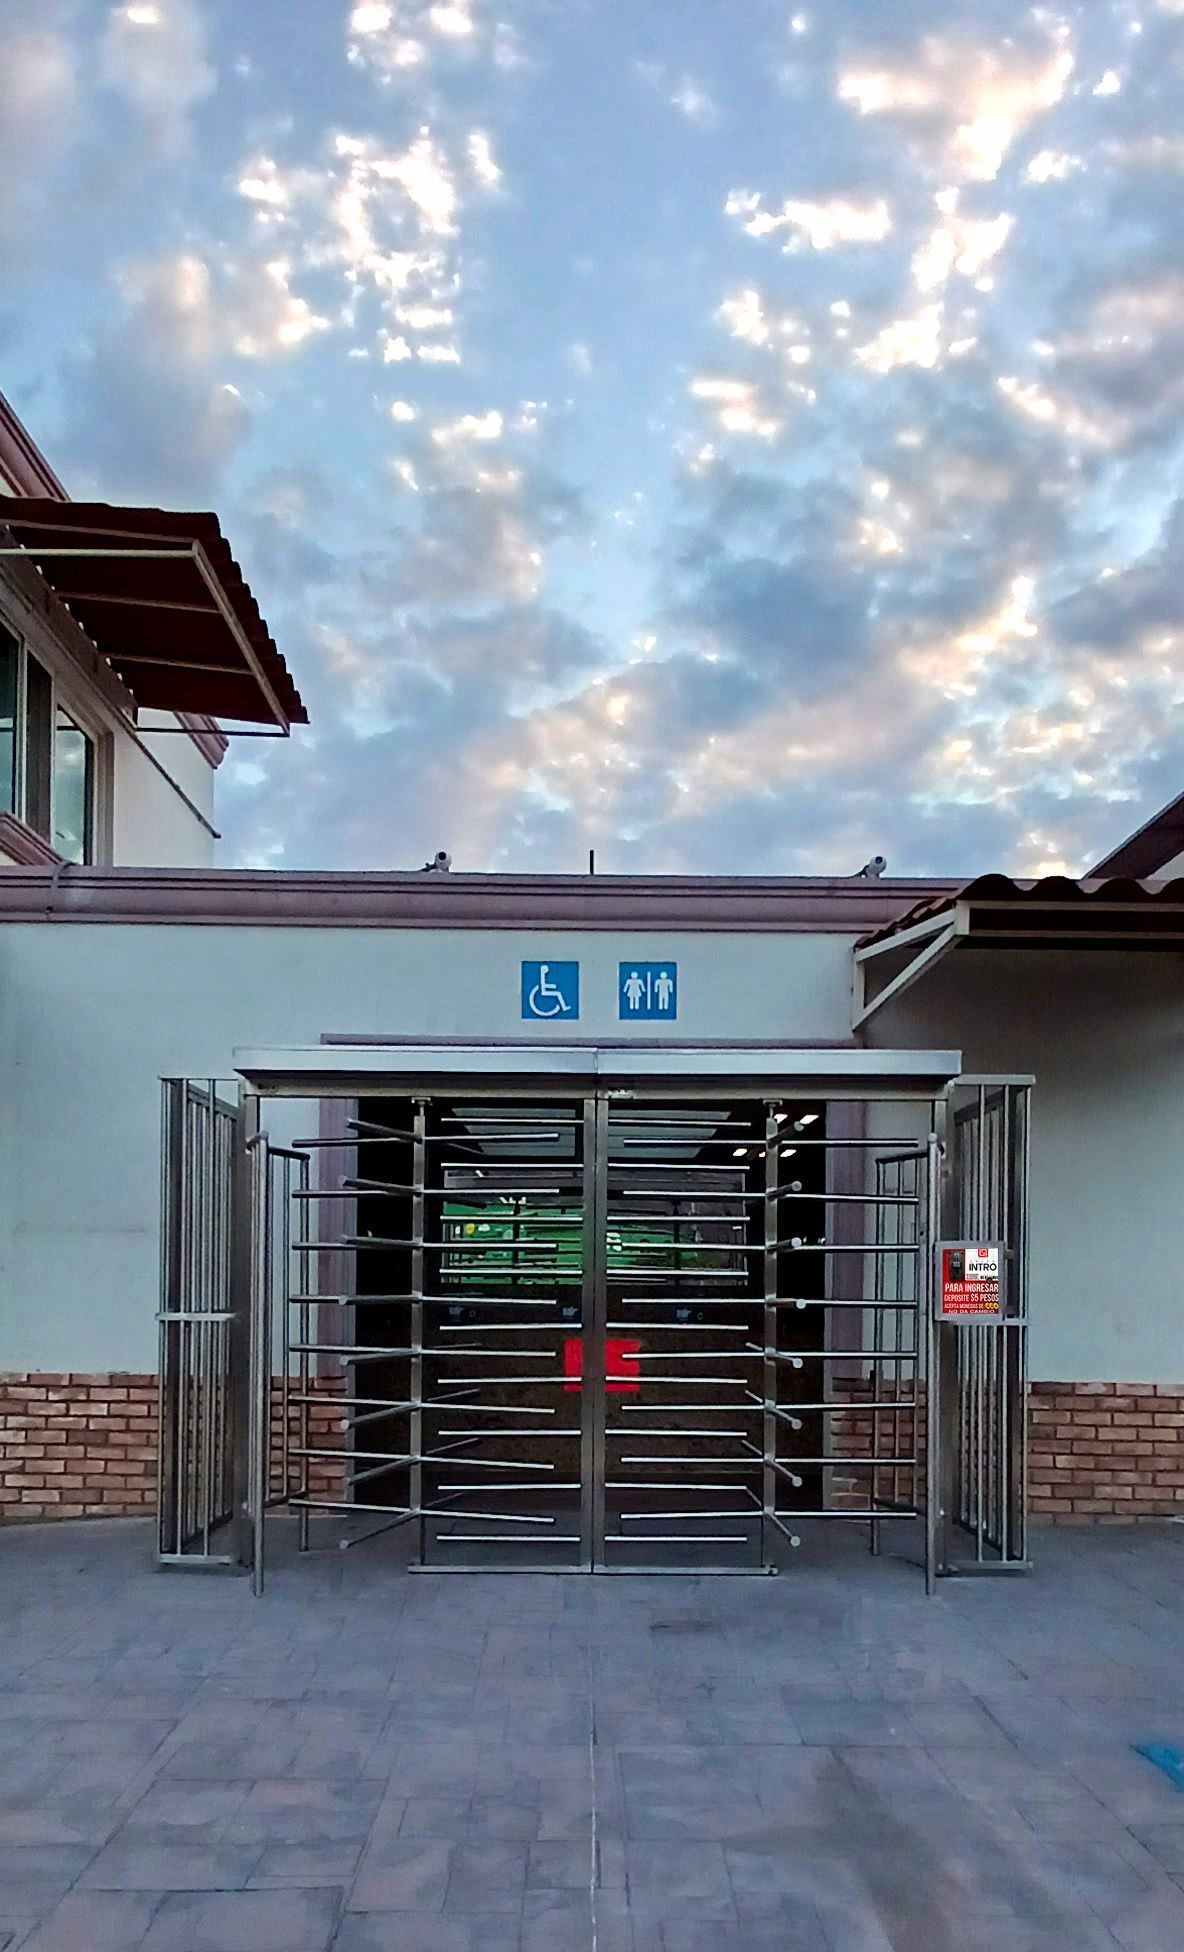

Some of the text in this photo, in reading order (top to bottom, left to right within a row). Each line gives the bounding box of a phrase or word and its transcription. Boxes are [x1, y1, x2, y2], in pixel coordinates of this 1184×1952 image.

[969, 1263, 997, 1271] INTRO
[945, 1283, 998, 1292] PARA INGRESAR
[971, 1294, 979, 1302] $5
